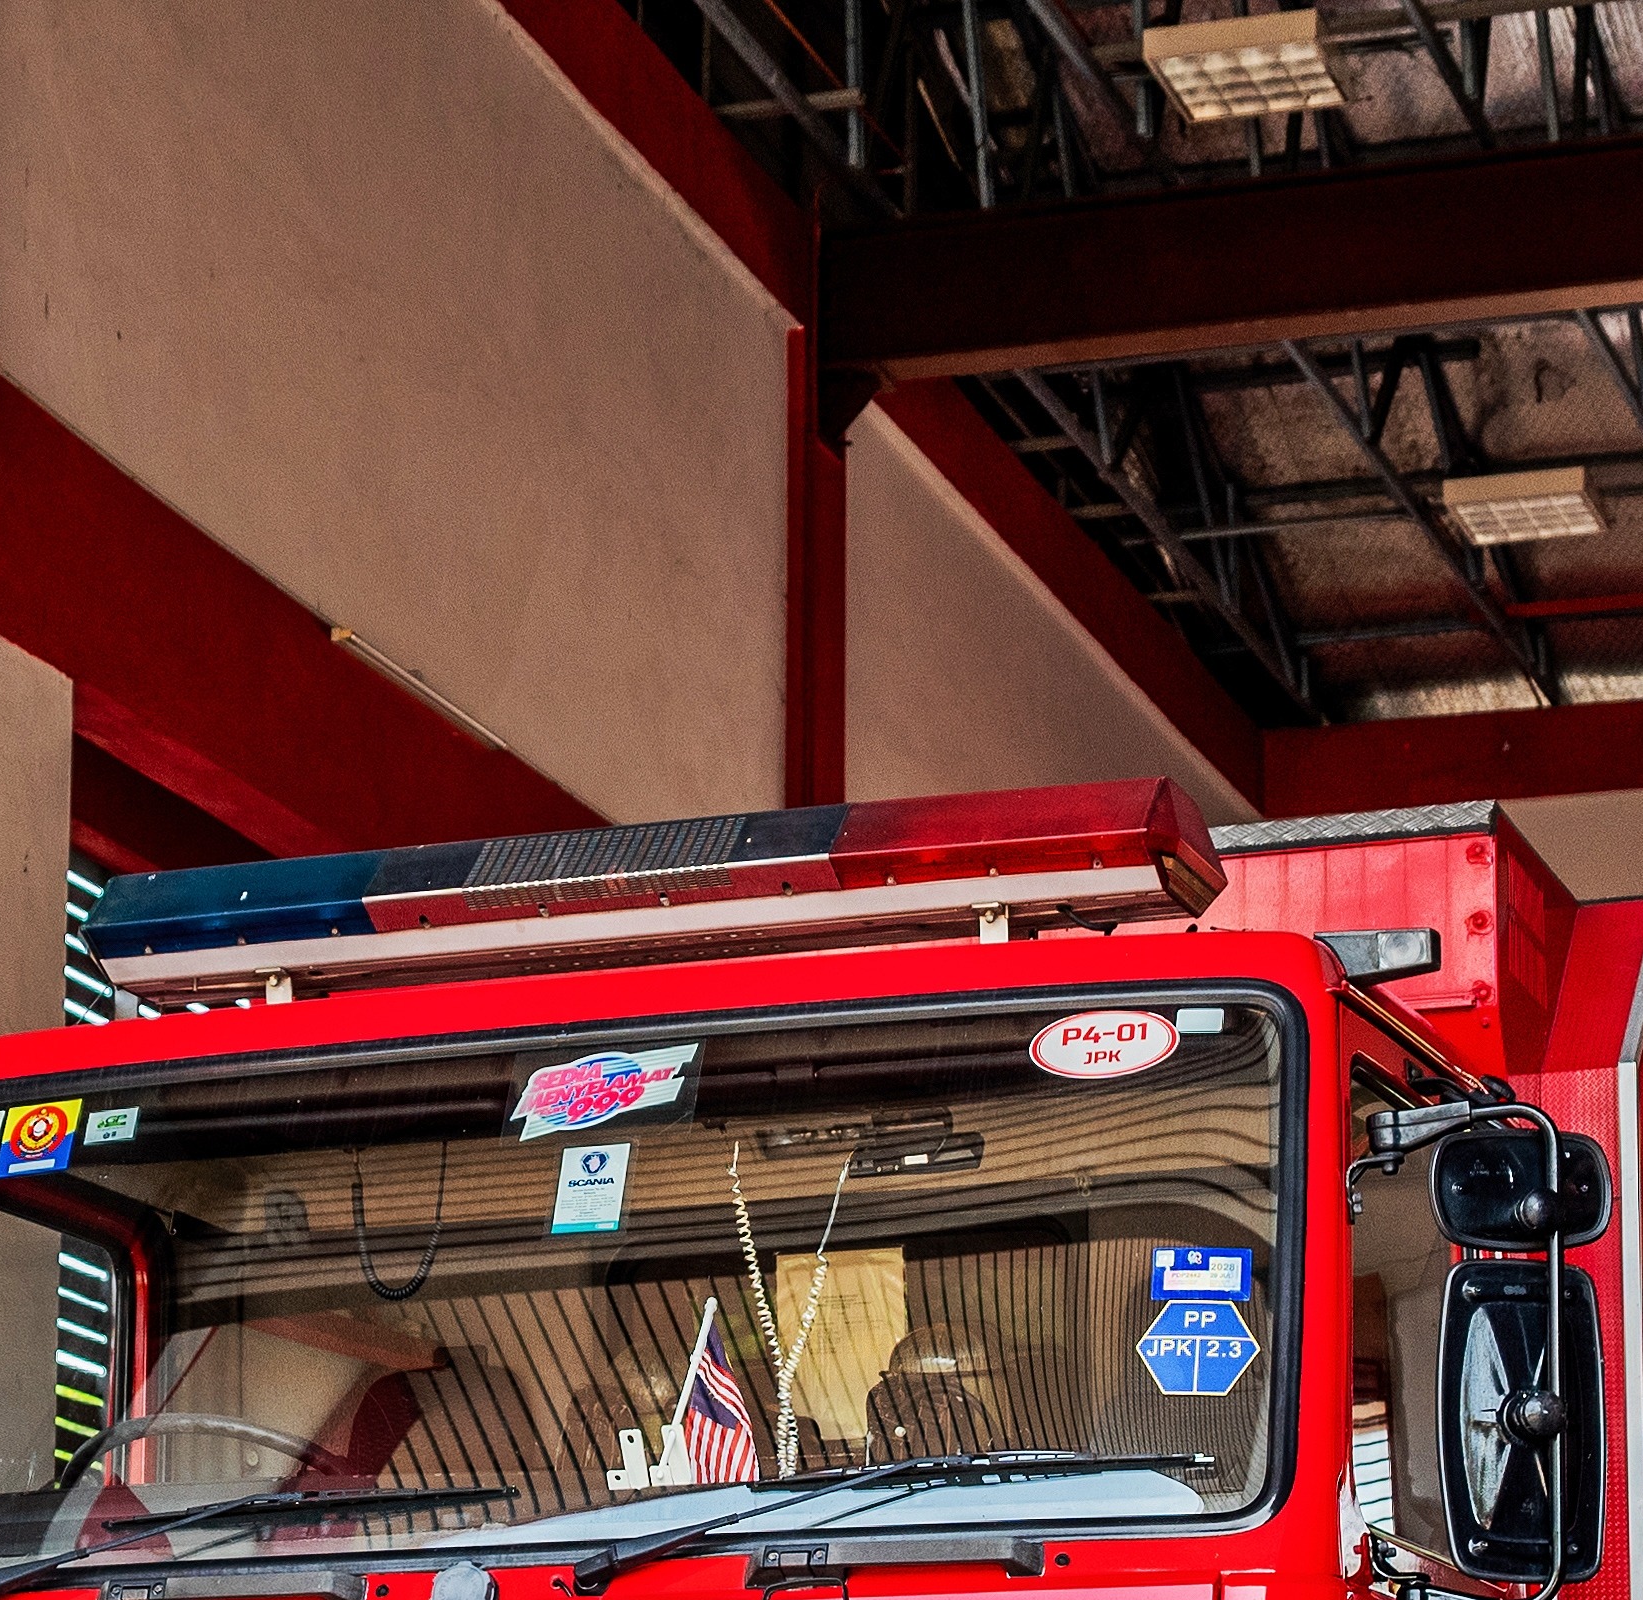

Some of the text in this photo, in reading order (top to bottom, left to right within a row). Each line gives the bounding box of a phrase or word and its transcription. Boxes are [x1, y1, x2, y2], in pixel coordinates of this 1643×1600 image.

[1061, 1022, 1149, 1046] P4-01
[1083, 1049, 1122, 1065] JPK
[532, 1062, 603, 1090] SEDIA
[520, 1067, 676, 1115] MENYELAMAT
[565, 1085, 646, 1125] 999
[568, 1177, 615, 1188] SCANIA
[1184, 1310, 1217, 1328] PP
[1146, 1339, 1192, 1357] JPK
[1206, 1340, 1242, 1358] 2.3
